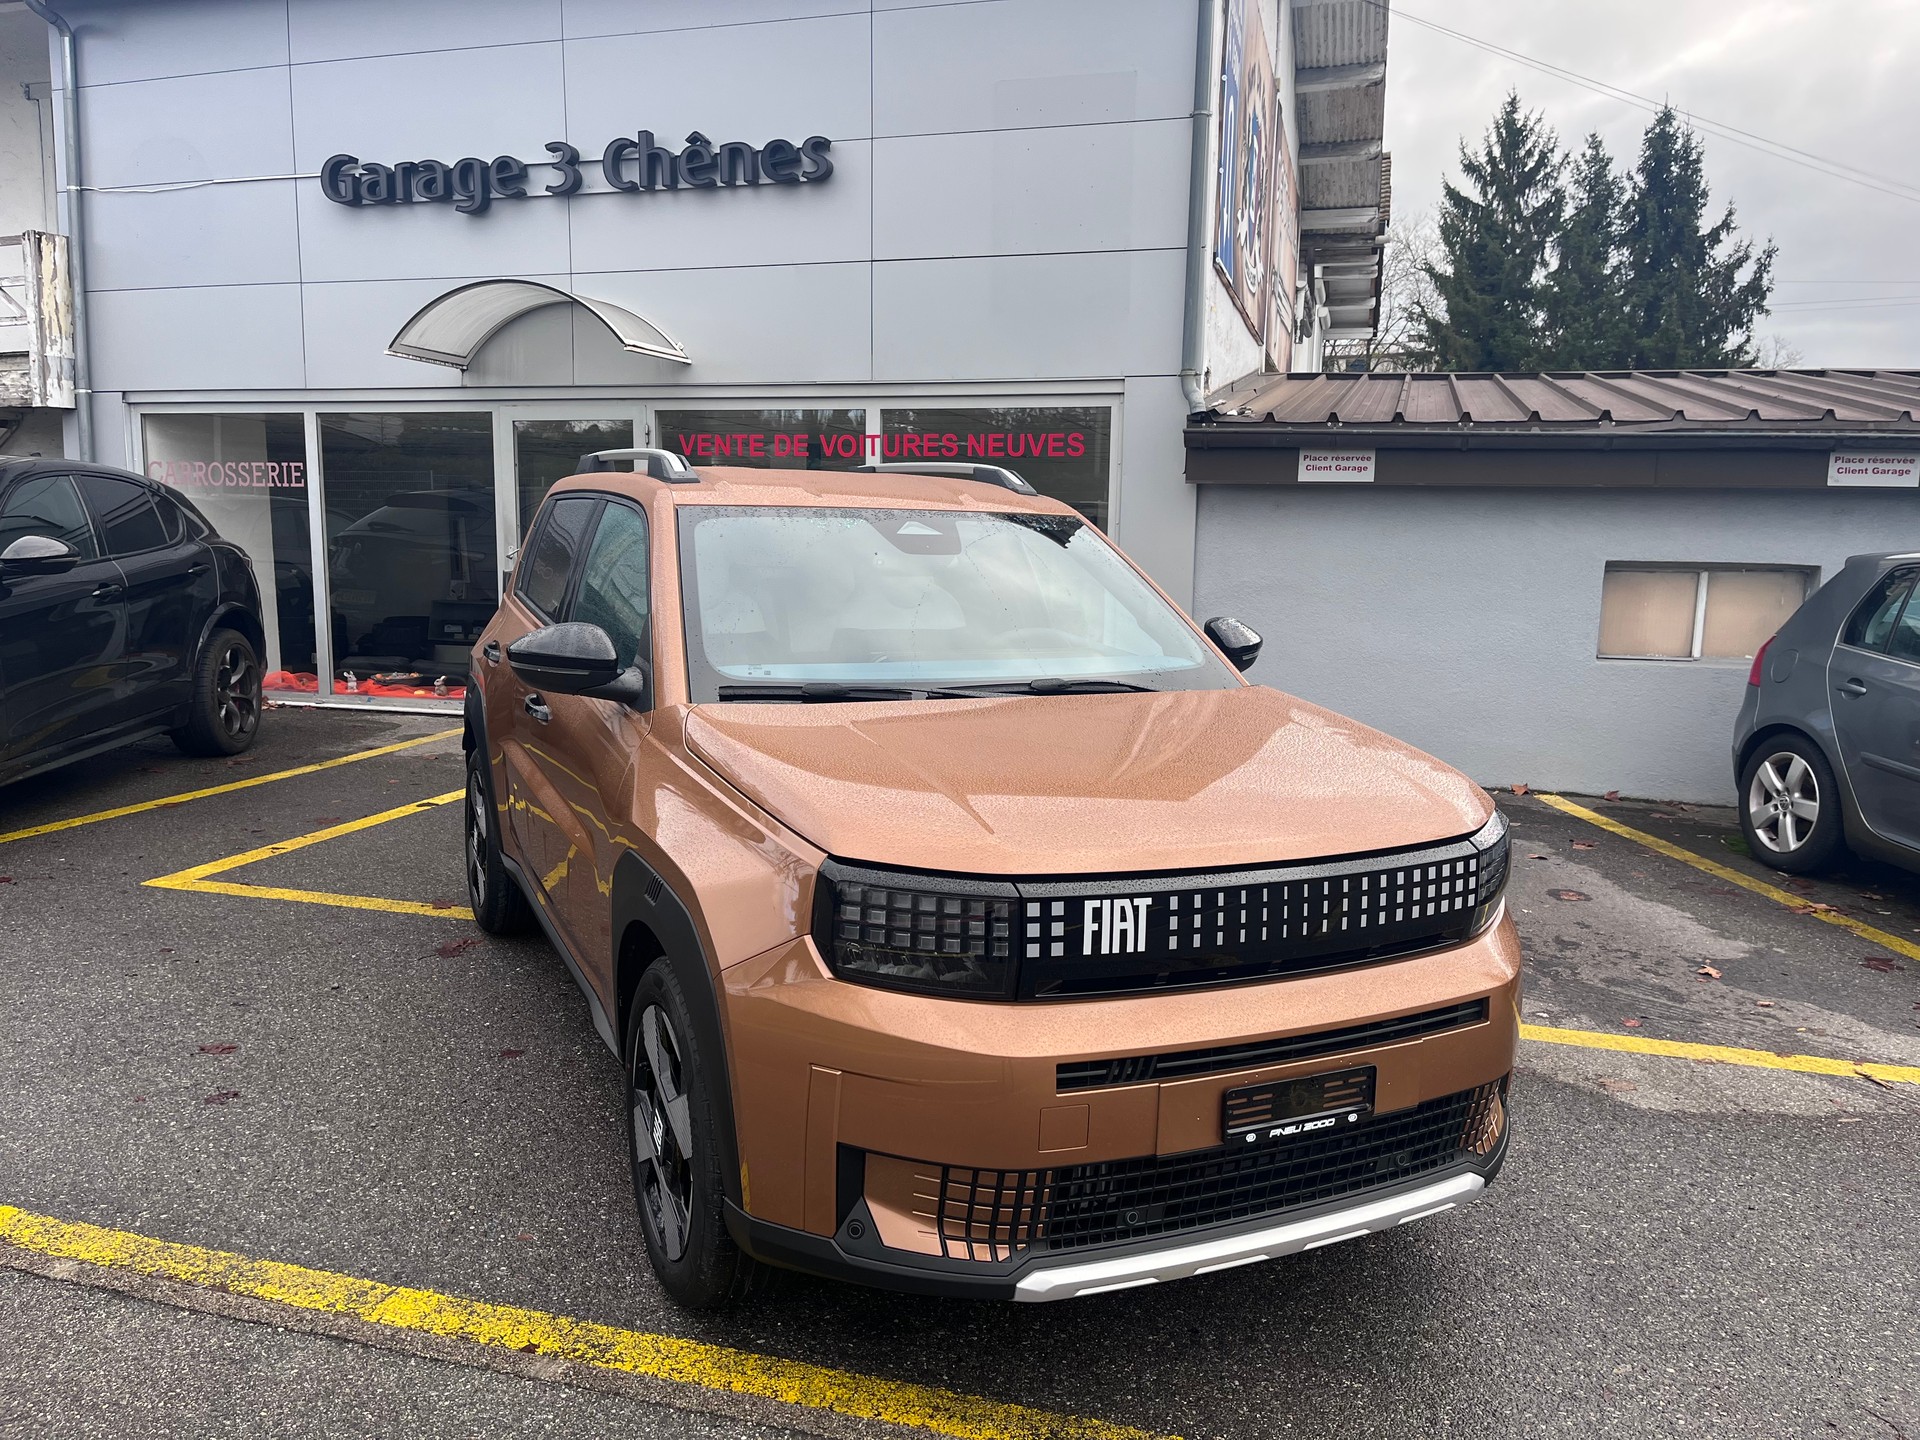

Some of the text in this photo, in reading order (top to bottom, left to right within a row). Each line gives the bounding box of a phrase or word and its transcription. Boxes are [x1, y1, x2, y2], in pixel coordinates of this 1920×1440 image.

[321, 130, 833, 215] Garage 3 Chênes
[679, 432, 1085, 457] VENTE DE VOITURES NEUVES
[1303, 454, 1372, 462] Place réservée
[1335, 464, 1368, 472] Garage
[1834, 455, 1915, 464] Place réservée
[148, 460, 305, 487] CARROSSERIE
[1837, 467, 1911, 476] Client Garage
[1083, 898, 1152, 955] FIAT
[1269, 1118, 1335, 1138] PNEU 2000
